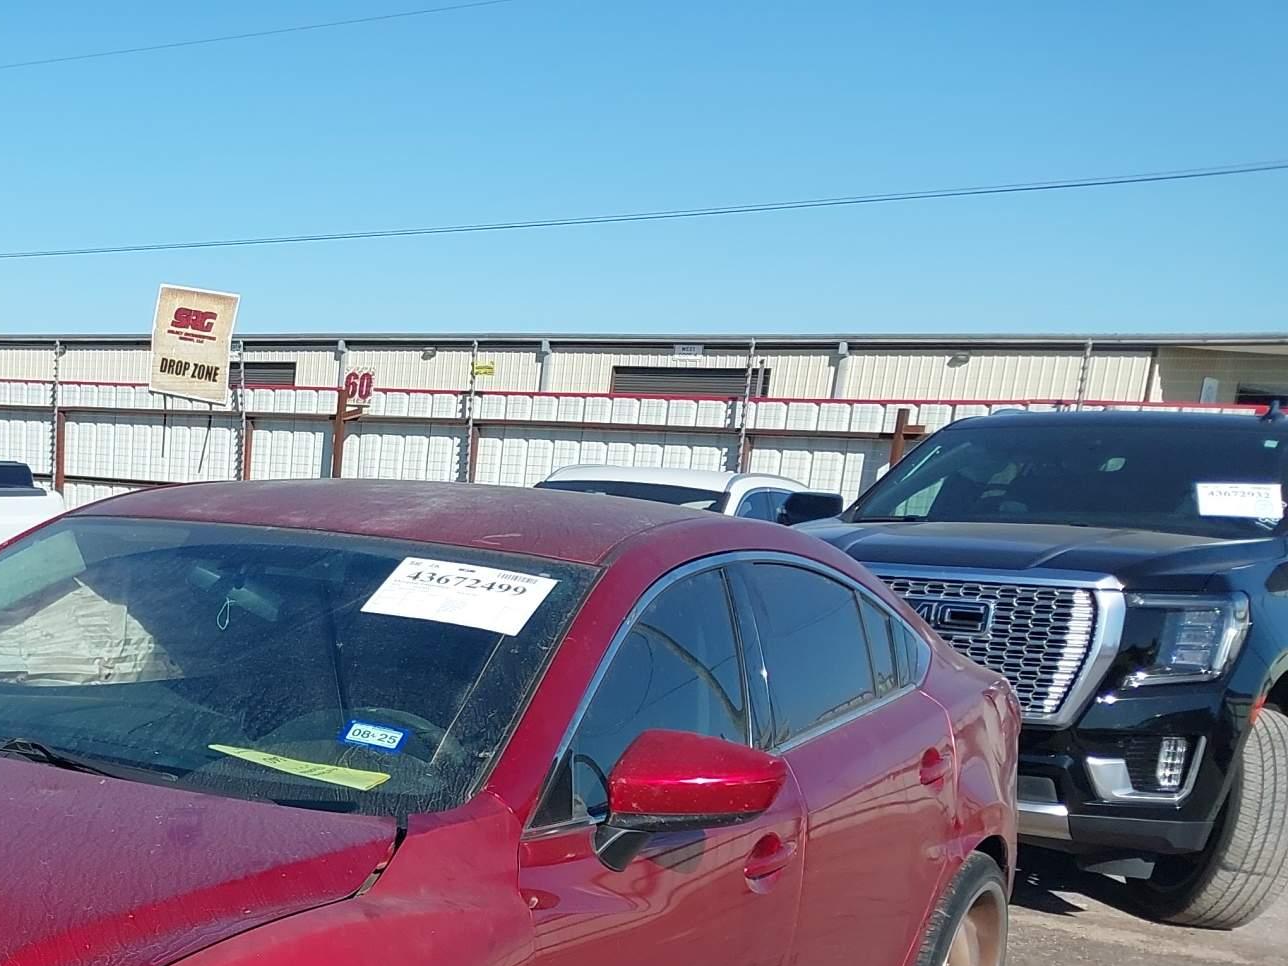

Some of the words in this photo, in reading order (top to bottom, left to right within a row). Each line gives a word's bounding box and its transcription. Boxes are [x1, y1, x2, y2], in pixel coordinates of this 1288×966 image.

[170, 307, 218, 333] SRG
[159, 357, 191, 377] DROP
[190, 362, 220, 383] ZONE
[345, 371, 374, 400] 60
[406, 570, 528, 597] 43672499
[915, 602, 987, 633] MC
